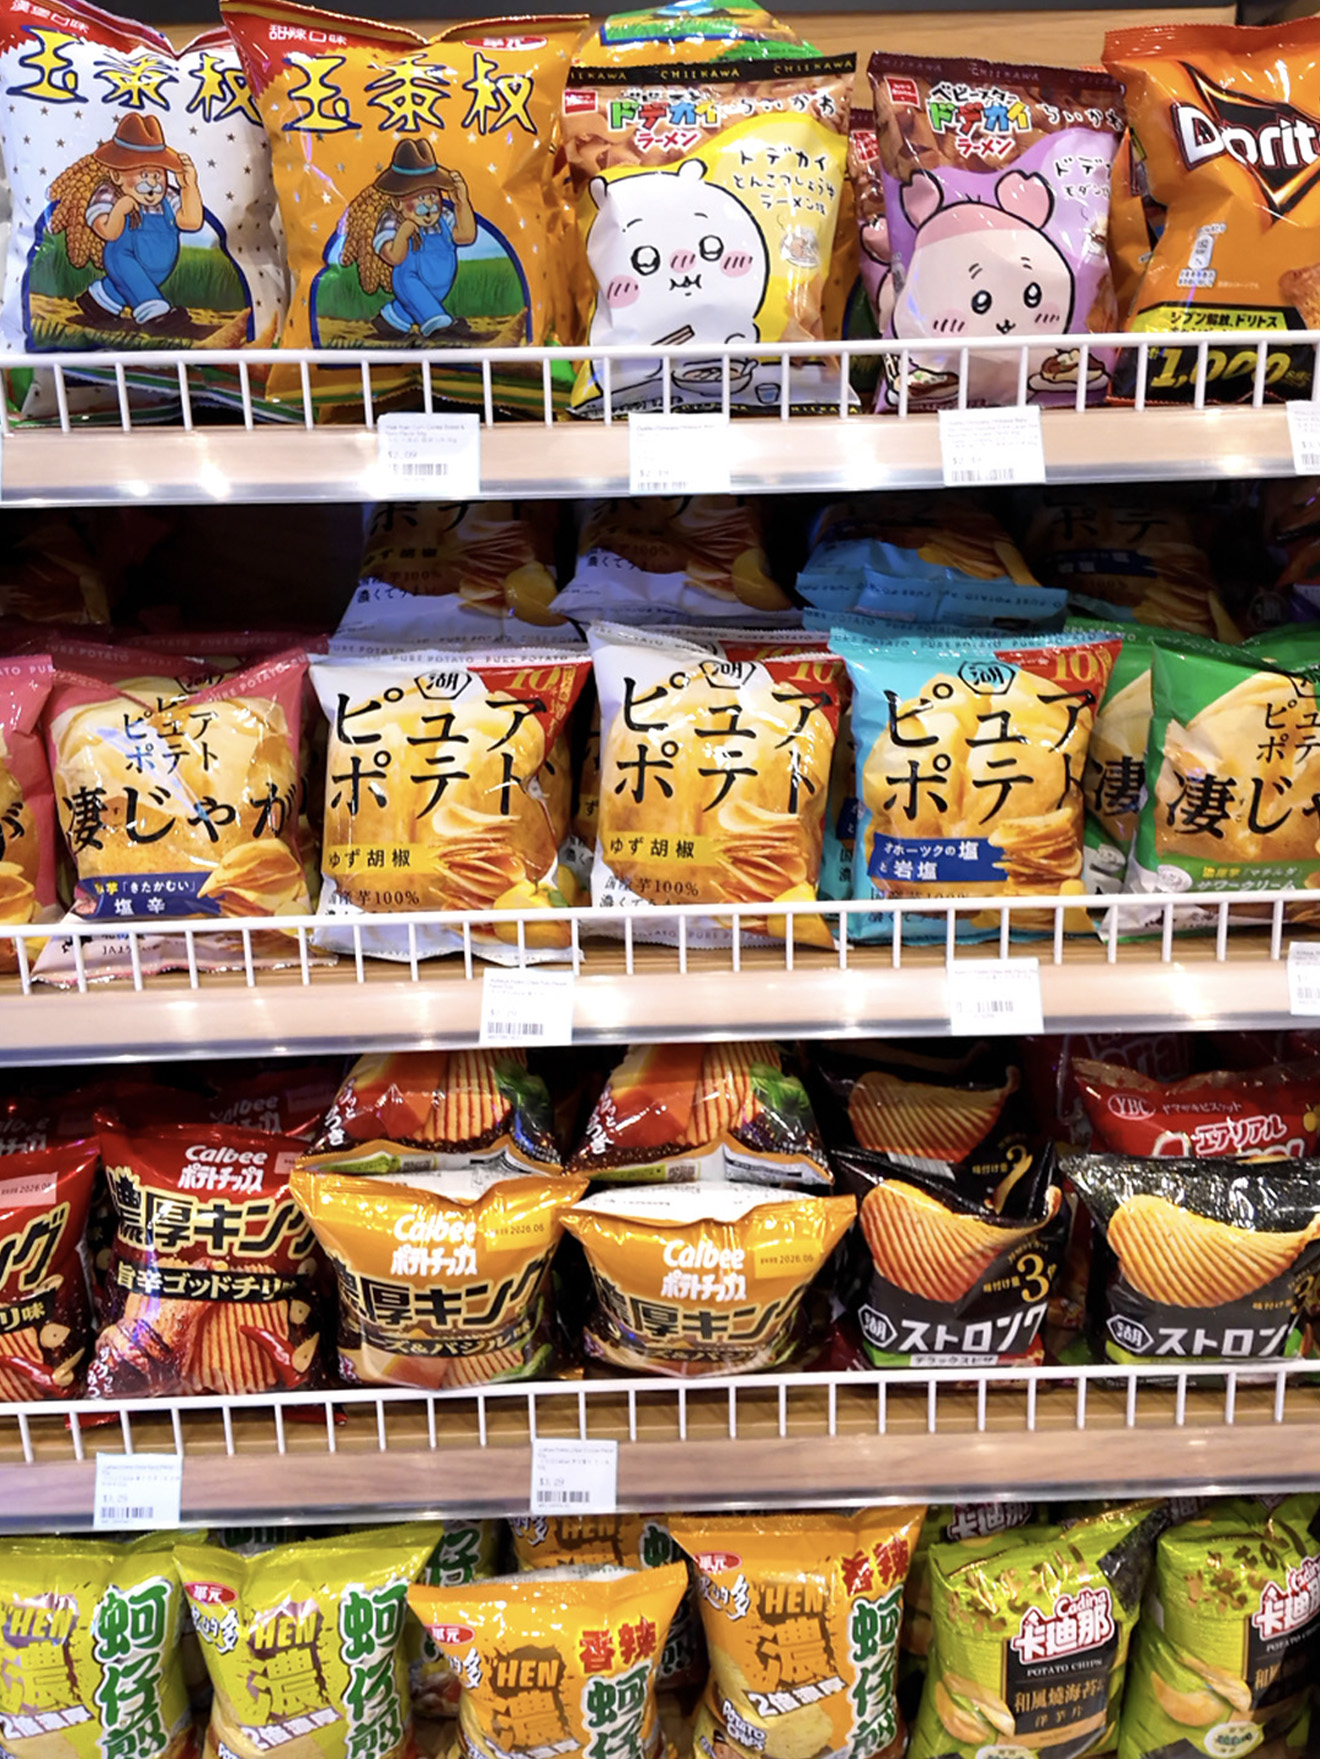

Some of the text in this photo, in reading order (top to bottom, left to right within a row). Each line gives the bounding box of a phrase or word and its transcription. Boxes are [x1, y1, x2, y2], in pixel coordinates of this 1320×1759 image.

[609, 101, 719, 129] ドデカイ
[927, 100, 1031, 134] ドデカイ
[636, 130, 699, 150] ラーメン
[956, 137, 1015, 157] ラーメン
[123, 709, 219, 741] ピュア
[336, 686, 548, 752] ピュア
[622, 671, 833, 750] ピュア
[883, 682, 1098, 753] ピュア
[125, 743, 219, 774] ポテト
[330, 750, 528, 820] ポテト
[613, 740, 817, 815] ポテト
[883, 753, 1086, 825] ポテト
[328, 848, 412, 869] ゆず胡椒
[610, 837, 696, 859] ゆず胡椒
[884, 840, 980, 862] オホーツクの塩
[879, 860, 939, 881] と岩塩
[1115, 1096, 1151, 1116] YBC
[1195, 1114, 1288, 1156] エアリアル
[184, 1144, 268, 1166] Calbee
[177, 1163, 265, 1192] ポテトチップス
[393, 1212, 478, 1243] Calbee
[391, 1246, 478, 1276] ポテトチップス
[663, 1239, 745, 1269] Calbee
[660, 1269, 746, 1302] ポテトチップス
[1055, 1589, 1108, 1618] Cadina
[1013, 1605, 1114, 1662] 卡迪那
[1026, 1664, 1070, 1678] POTATO
